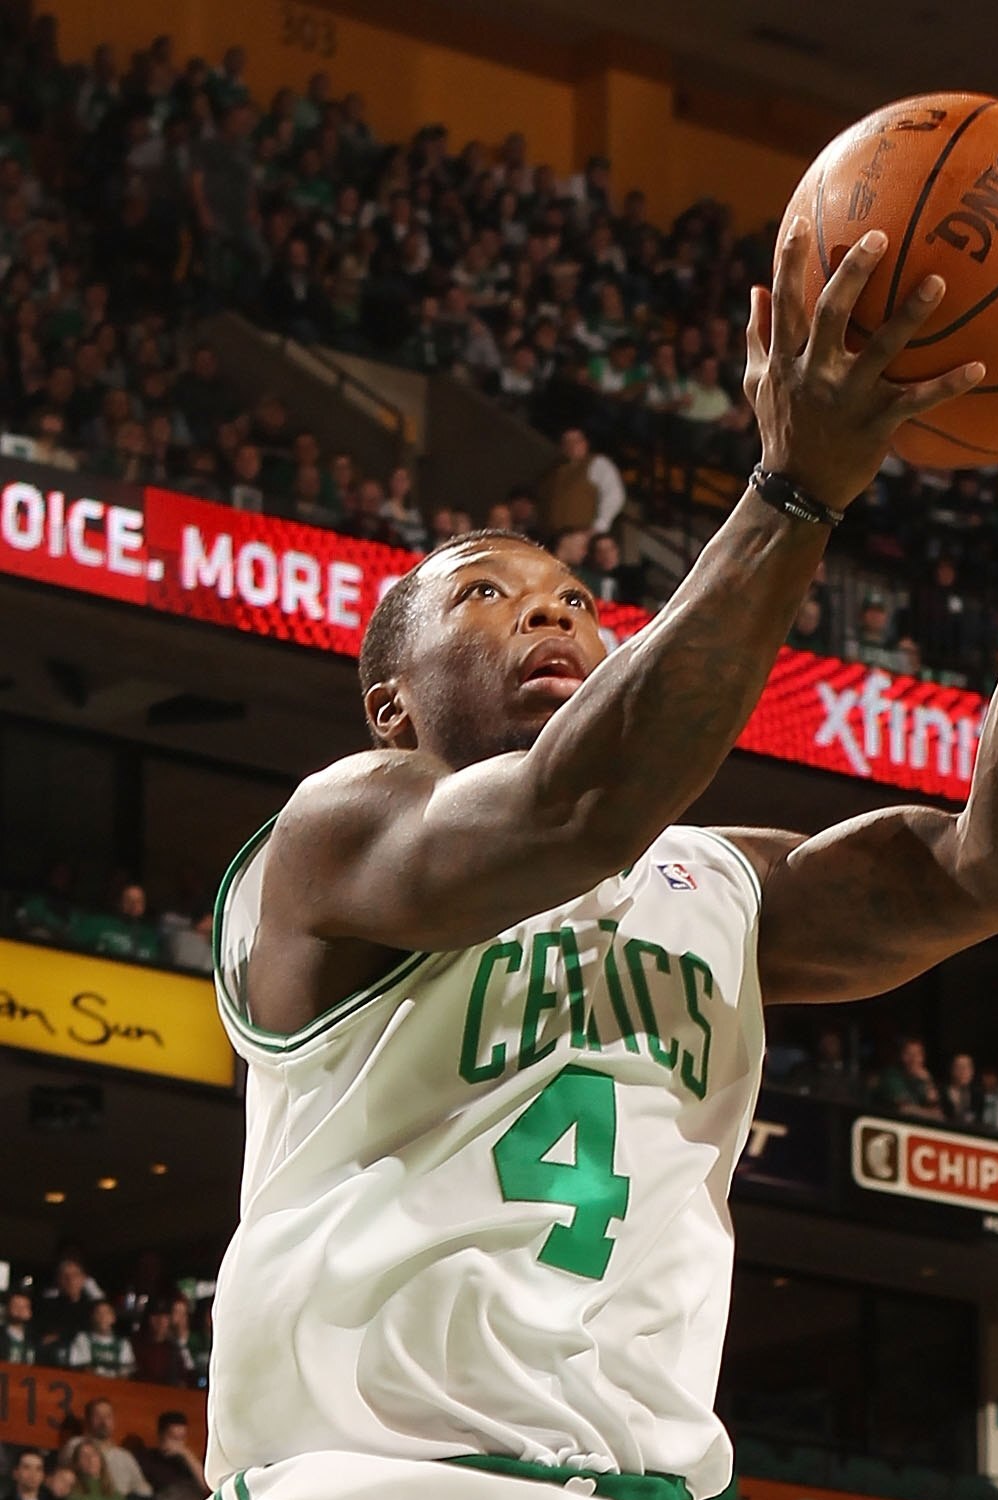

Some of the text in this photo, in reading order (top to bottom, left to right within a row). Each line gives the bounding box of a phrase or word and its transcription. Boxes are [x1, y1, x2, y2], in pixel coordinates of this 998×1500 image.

[1, 481, 363, 628] OICE. MORE
[815, 668, 988, 781] xfini
[67, 990, 165, 1048] Sun
[491, 1063, 630, 1280] 4
